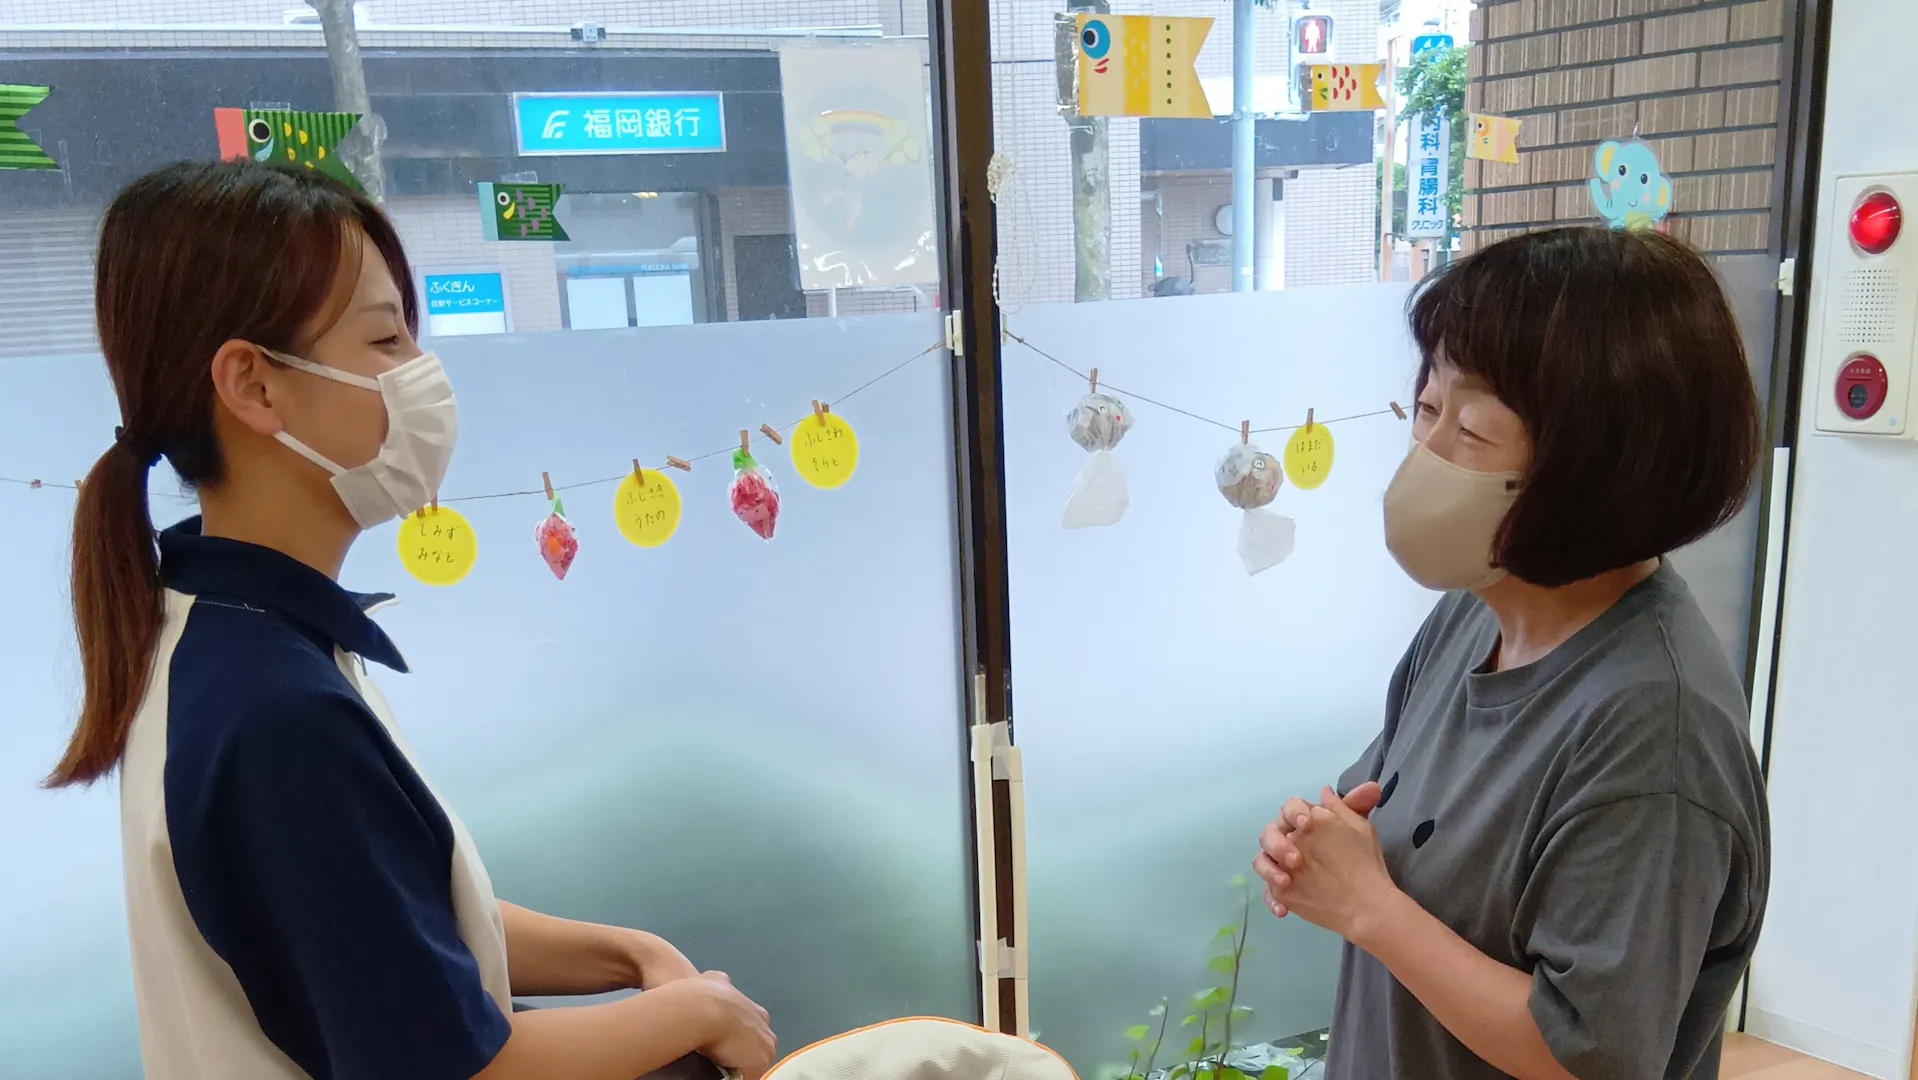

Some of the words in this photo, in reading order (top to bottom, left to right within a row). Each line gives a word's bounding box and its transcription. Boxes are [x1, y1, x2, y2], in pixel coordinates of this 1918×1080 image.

[582, 108, 700, 139] 福岡銀行
[1411, 219, 1443, 230] クリニック
[430, 281, 475, 294] ふくぎん
[420, 523, 460, 541] しみず
[417, 547, 455, 563] みなと
